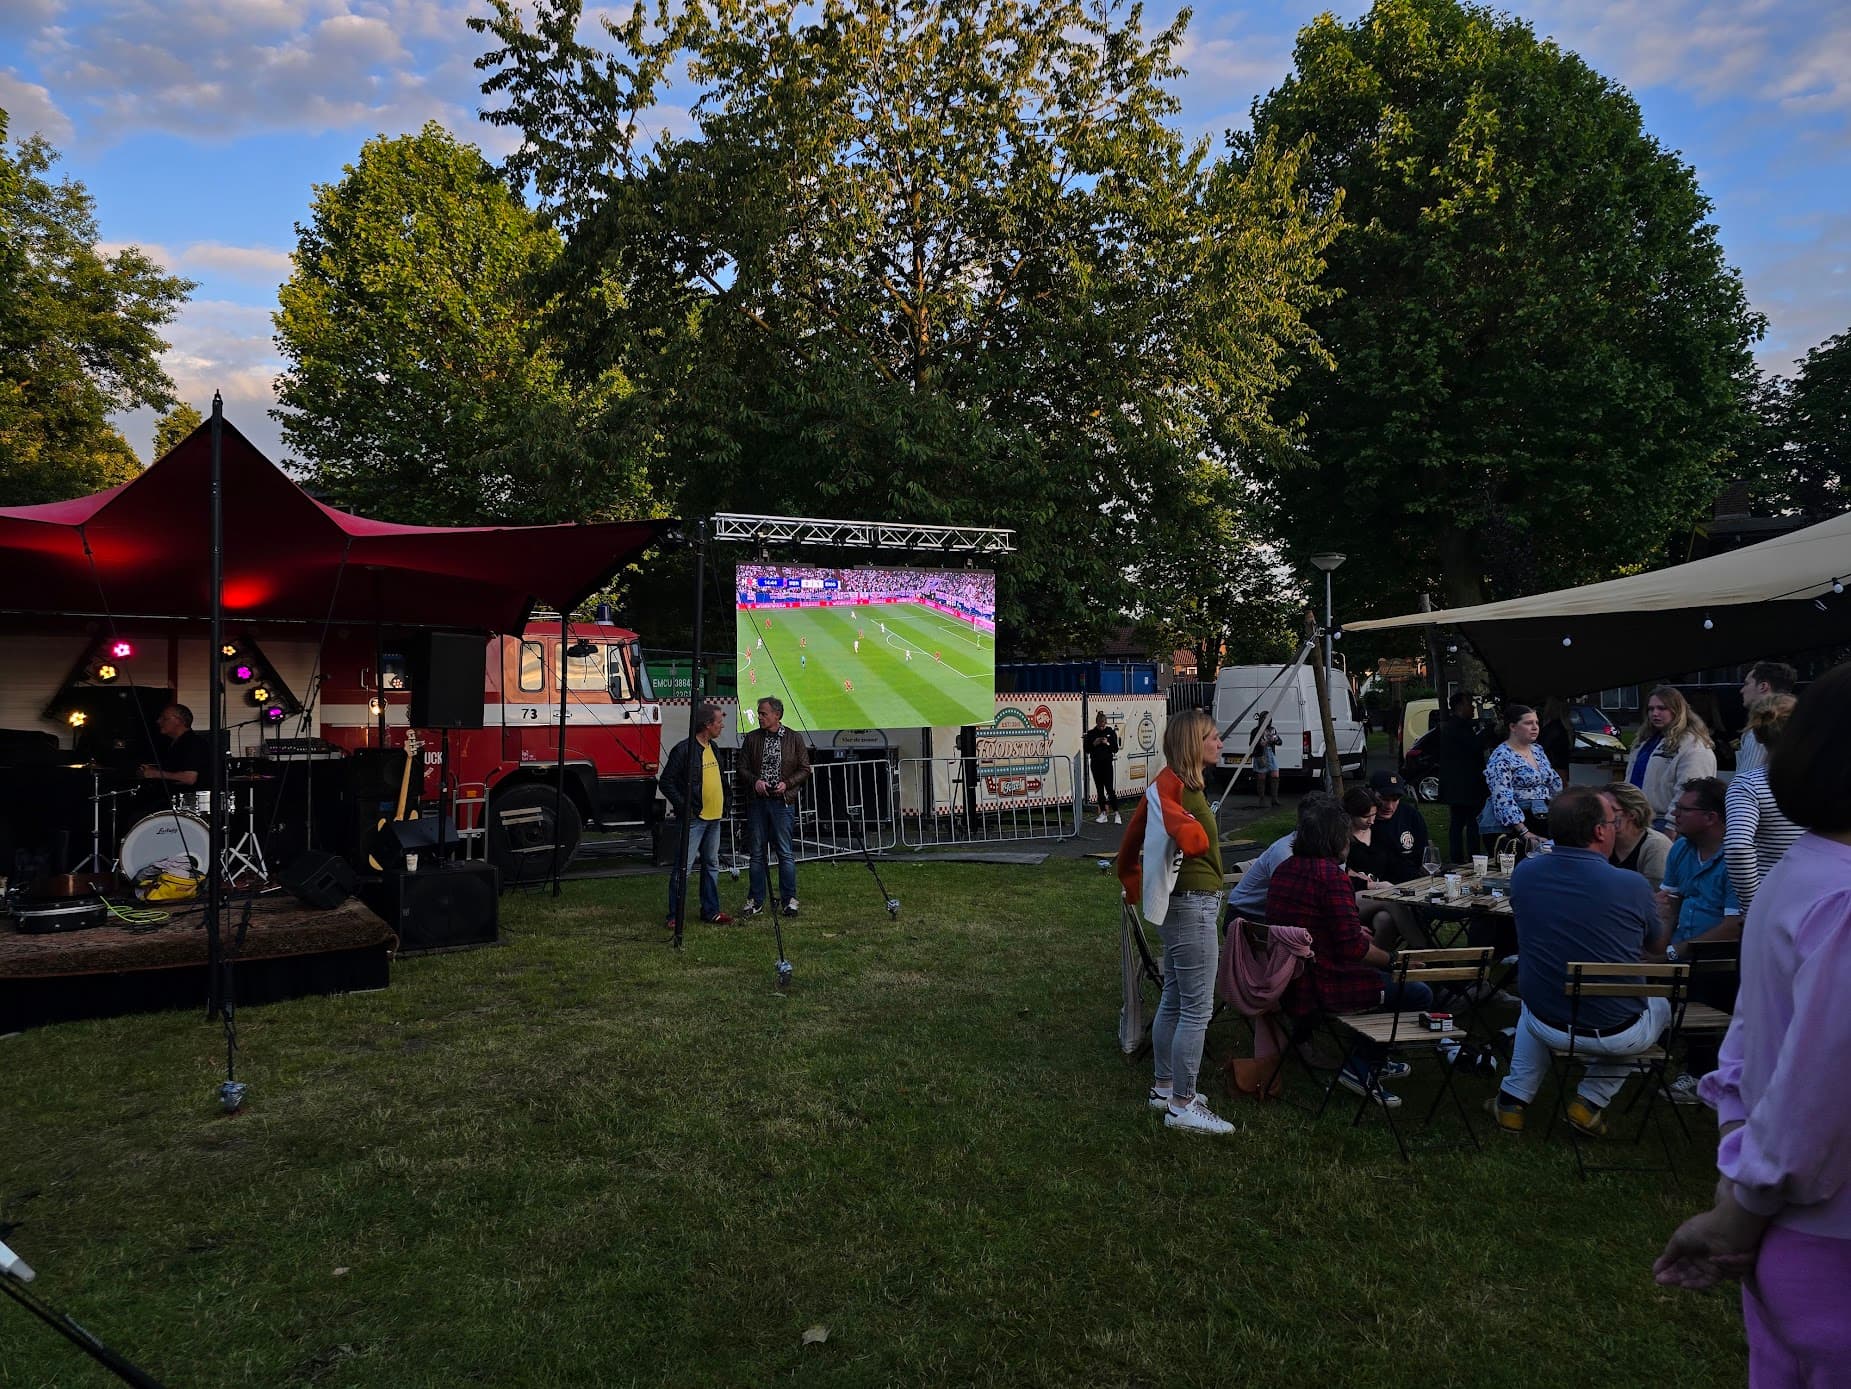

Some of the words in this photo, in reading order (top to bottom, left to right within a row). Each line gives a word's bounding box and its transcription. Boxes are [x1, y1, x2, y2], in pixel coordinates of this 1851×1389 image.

[652, 679, 673, 688] EMCU
[521, 708, 538, 719] 73
[424, 752, 443, 765] UCK
